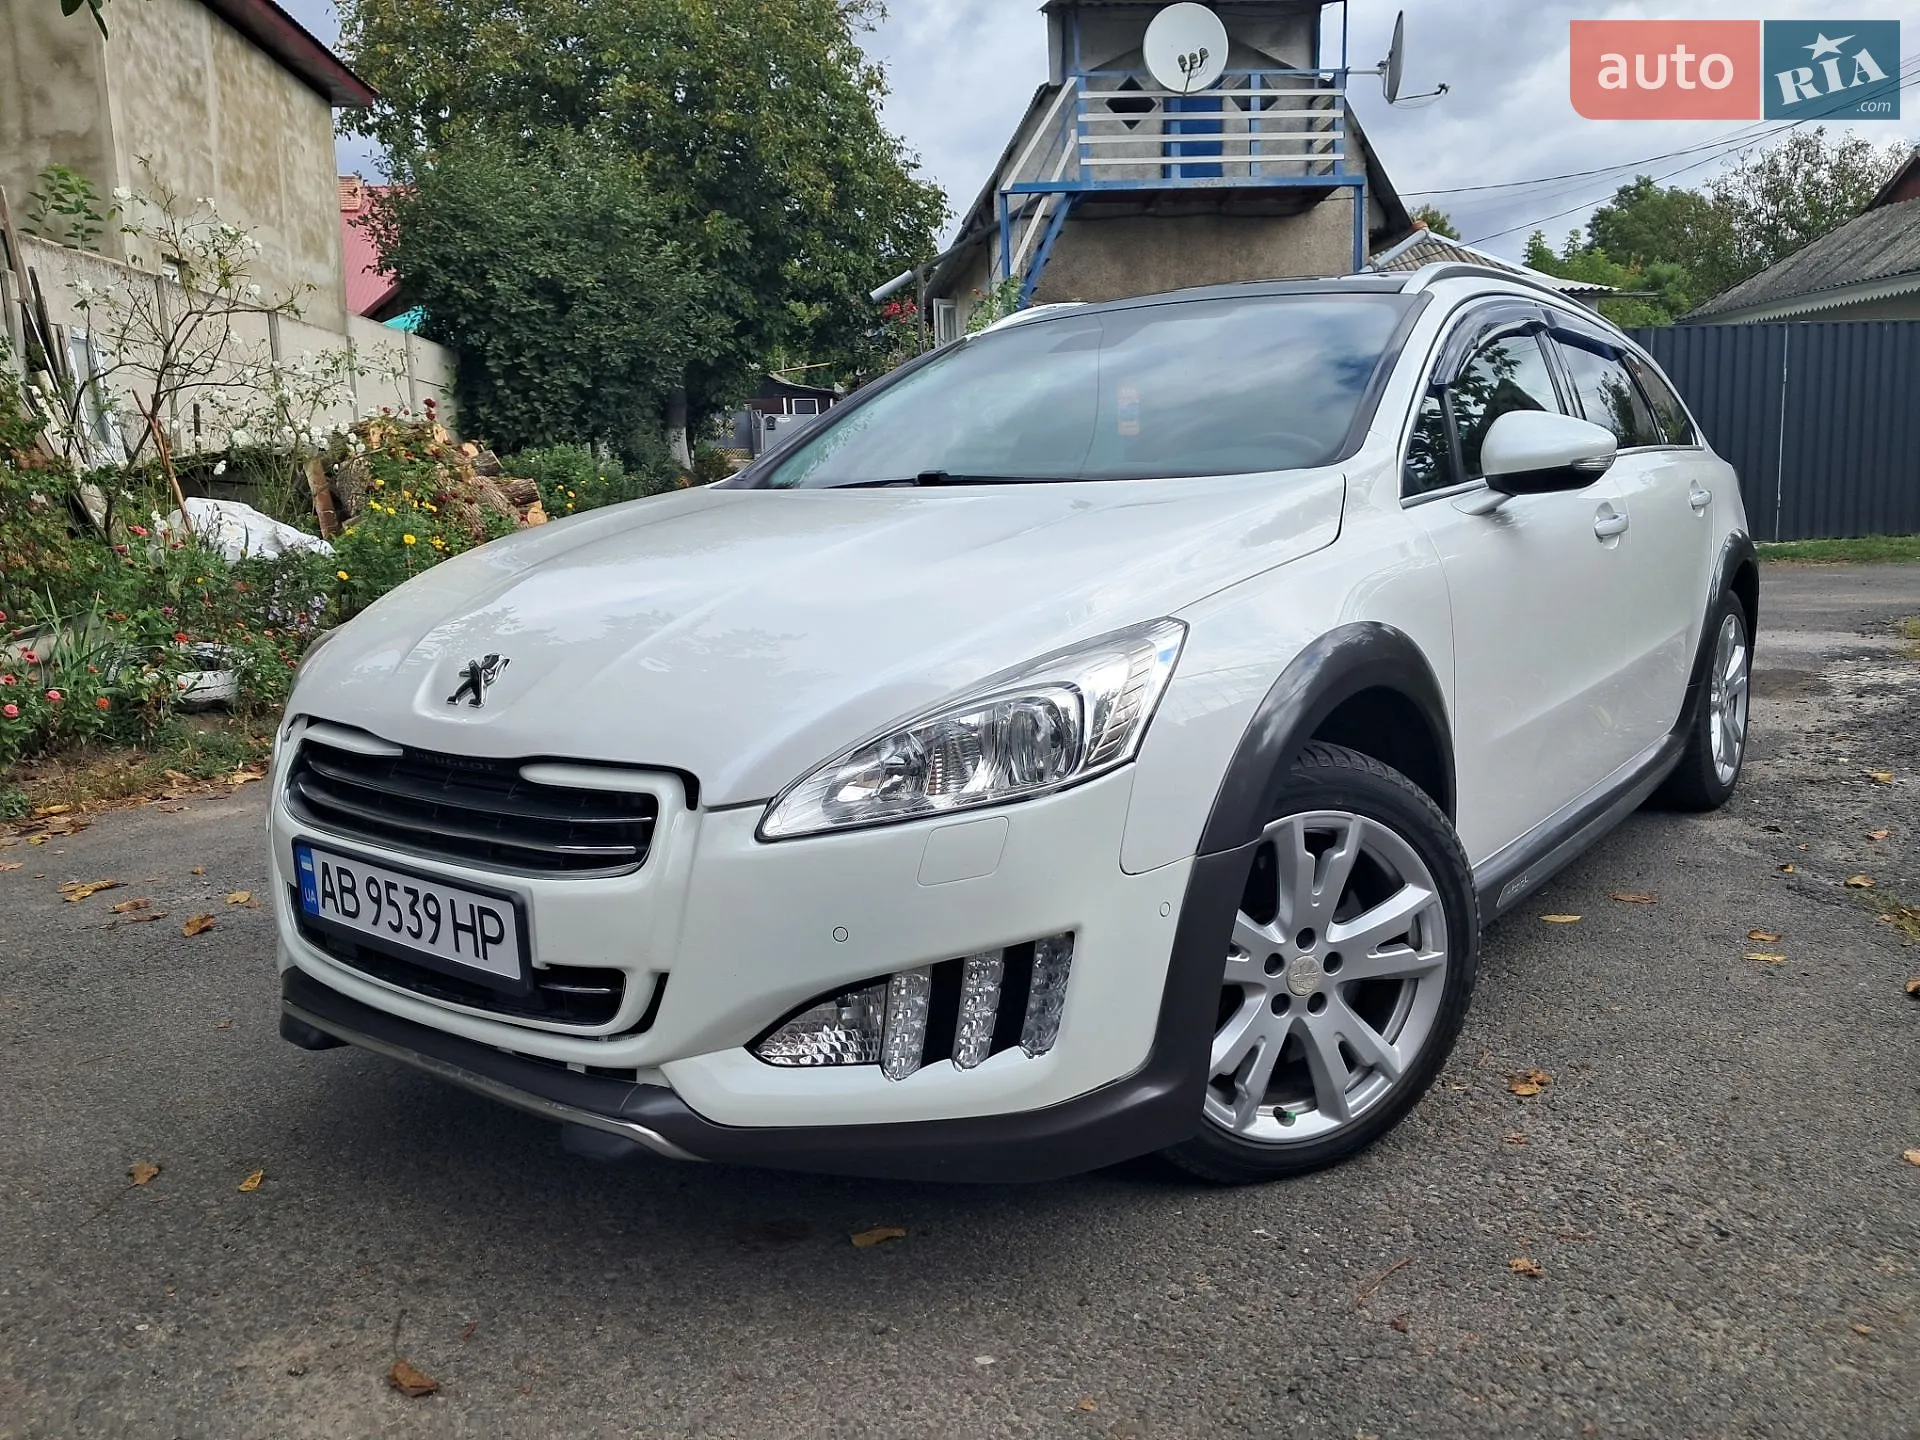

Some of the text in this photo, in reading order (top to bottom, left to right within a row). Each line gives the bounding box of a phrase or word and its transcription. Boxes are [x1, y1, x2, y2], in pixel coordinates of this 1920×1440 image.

[304, 887, 317, 904] UA
[321, 861, 505, 961] AB 9539 HP
